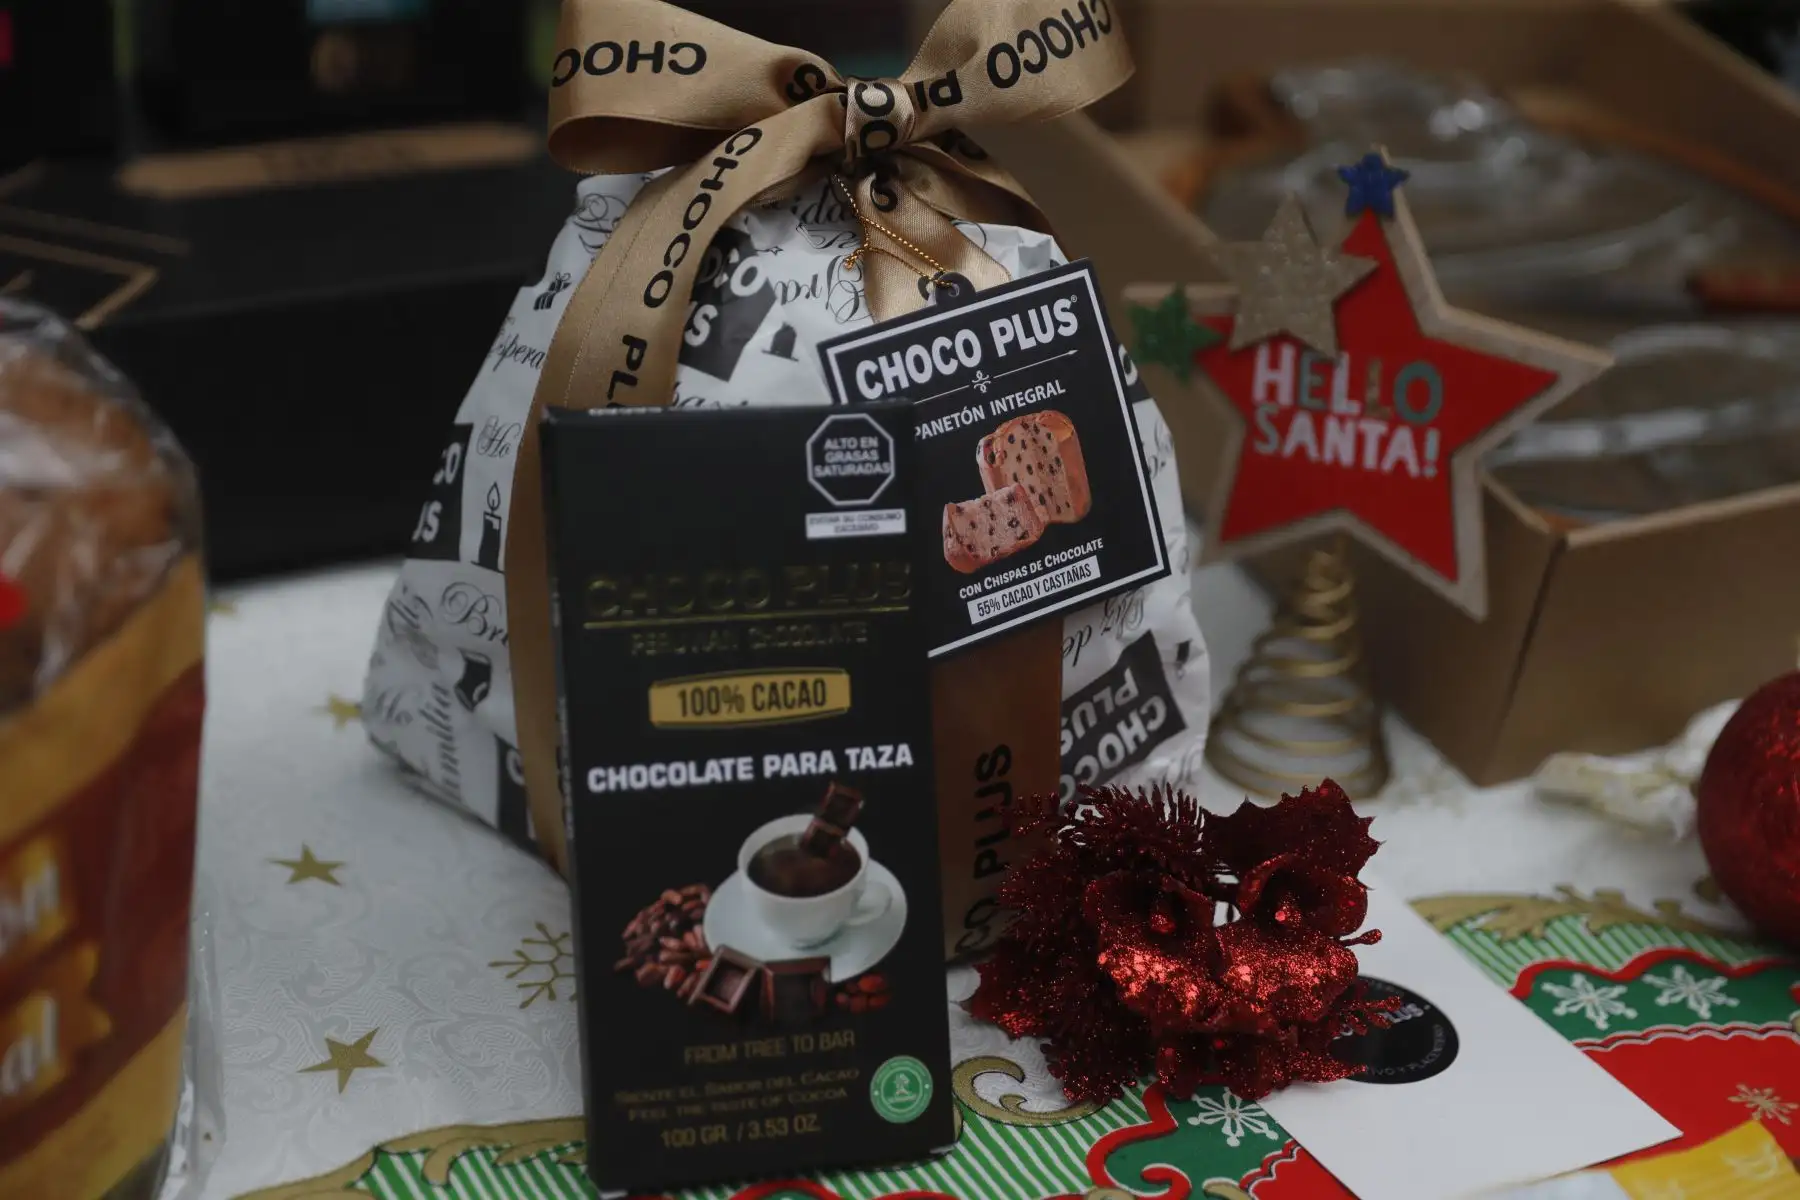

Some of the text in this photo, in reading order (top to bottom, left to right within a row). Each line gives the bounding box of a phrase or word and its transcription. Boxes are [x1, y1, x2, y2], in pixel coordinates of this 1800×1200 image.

[643, 127, 763, 308] CHOCO
[606, 334, 648, 408] PL
[855, 328, 983, 400] CHOCO
[1252, 342, 1443, 424] HELLO
[990, 380, 1067, 416] INTEGRAL
[824, 436, 879, 450] ALTO EN
[824, 449, 879, 463] GRASAS
[1254, 402, 1440, 478] SANTA!
[814, 461, 891, 477] SATURADAS
[585, 569, 771, 618] CHOCO
[959, 582, 982, 599] CON
[1029, 560, 1044, 574] DE
[976, 562, 1092, 617] 55% CACAO Y CASTAÑAS
[678, 678, 827, 718] 100% CACAO
[587, 743, 914, 794] CHOCOLATE PARA TAZA
[684, 1029, 856, 1065] FROM TREE TO BAR
[659, 1127, 696, 1149] 100
[747, 1115, 790, 1141] 3.53
